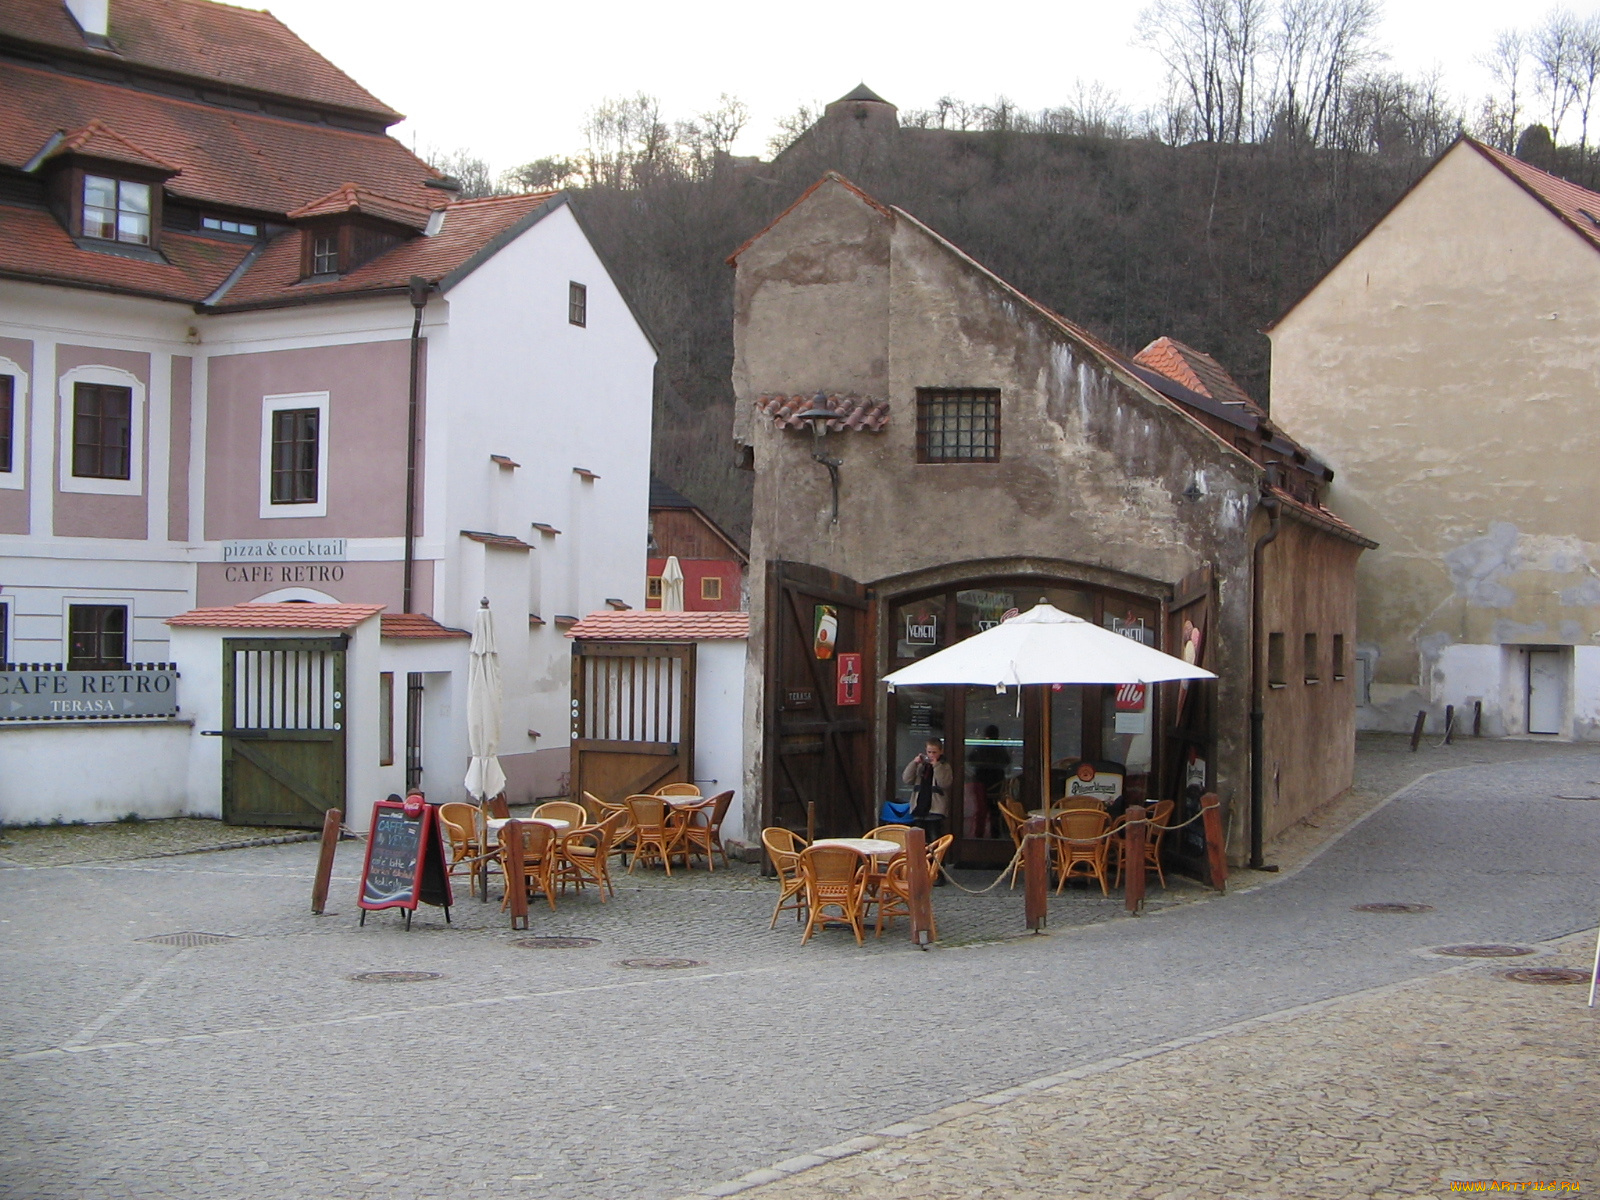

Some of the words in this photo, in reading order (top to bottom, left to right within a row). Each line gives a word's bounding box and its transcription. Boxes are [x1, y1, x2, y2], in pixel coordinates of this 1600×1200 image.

[223, 541, 263, 561] pizza
[266, 541, 277, 556] &
[281, 540, 343, 556] cocktail
[225, 566, 274, 582] CAFE
[281, 565, 344, 582] RETRO
[81, 674, 171, 694] RETRO
[788, 692, 812, 701] TERASA
[1116, 684, 1143, 706] illy
[50, 699, 115, 713] TERASA
